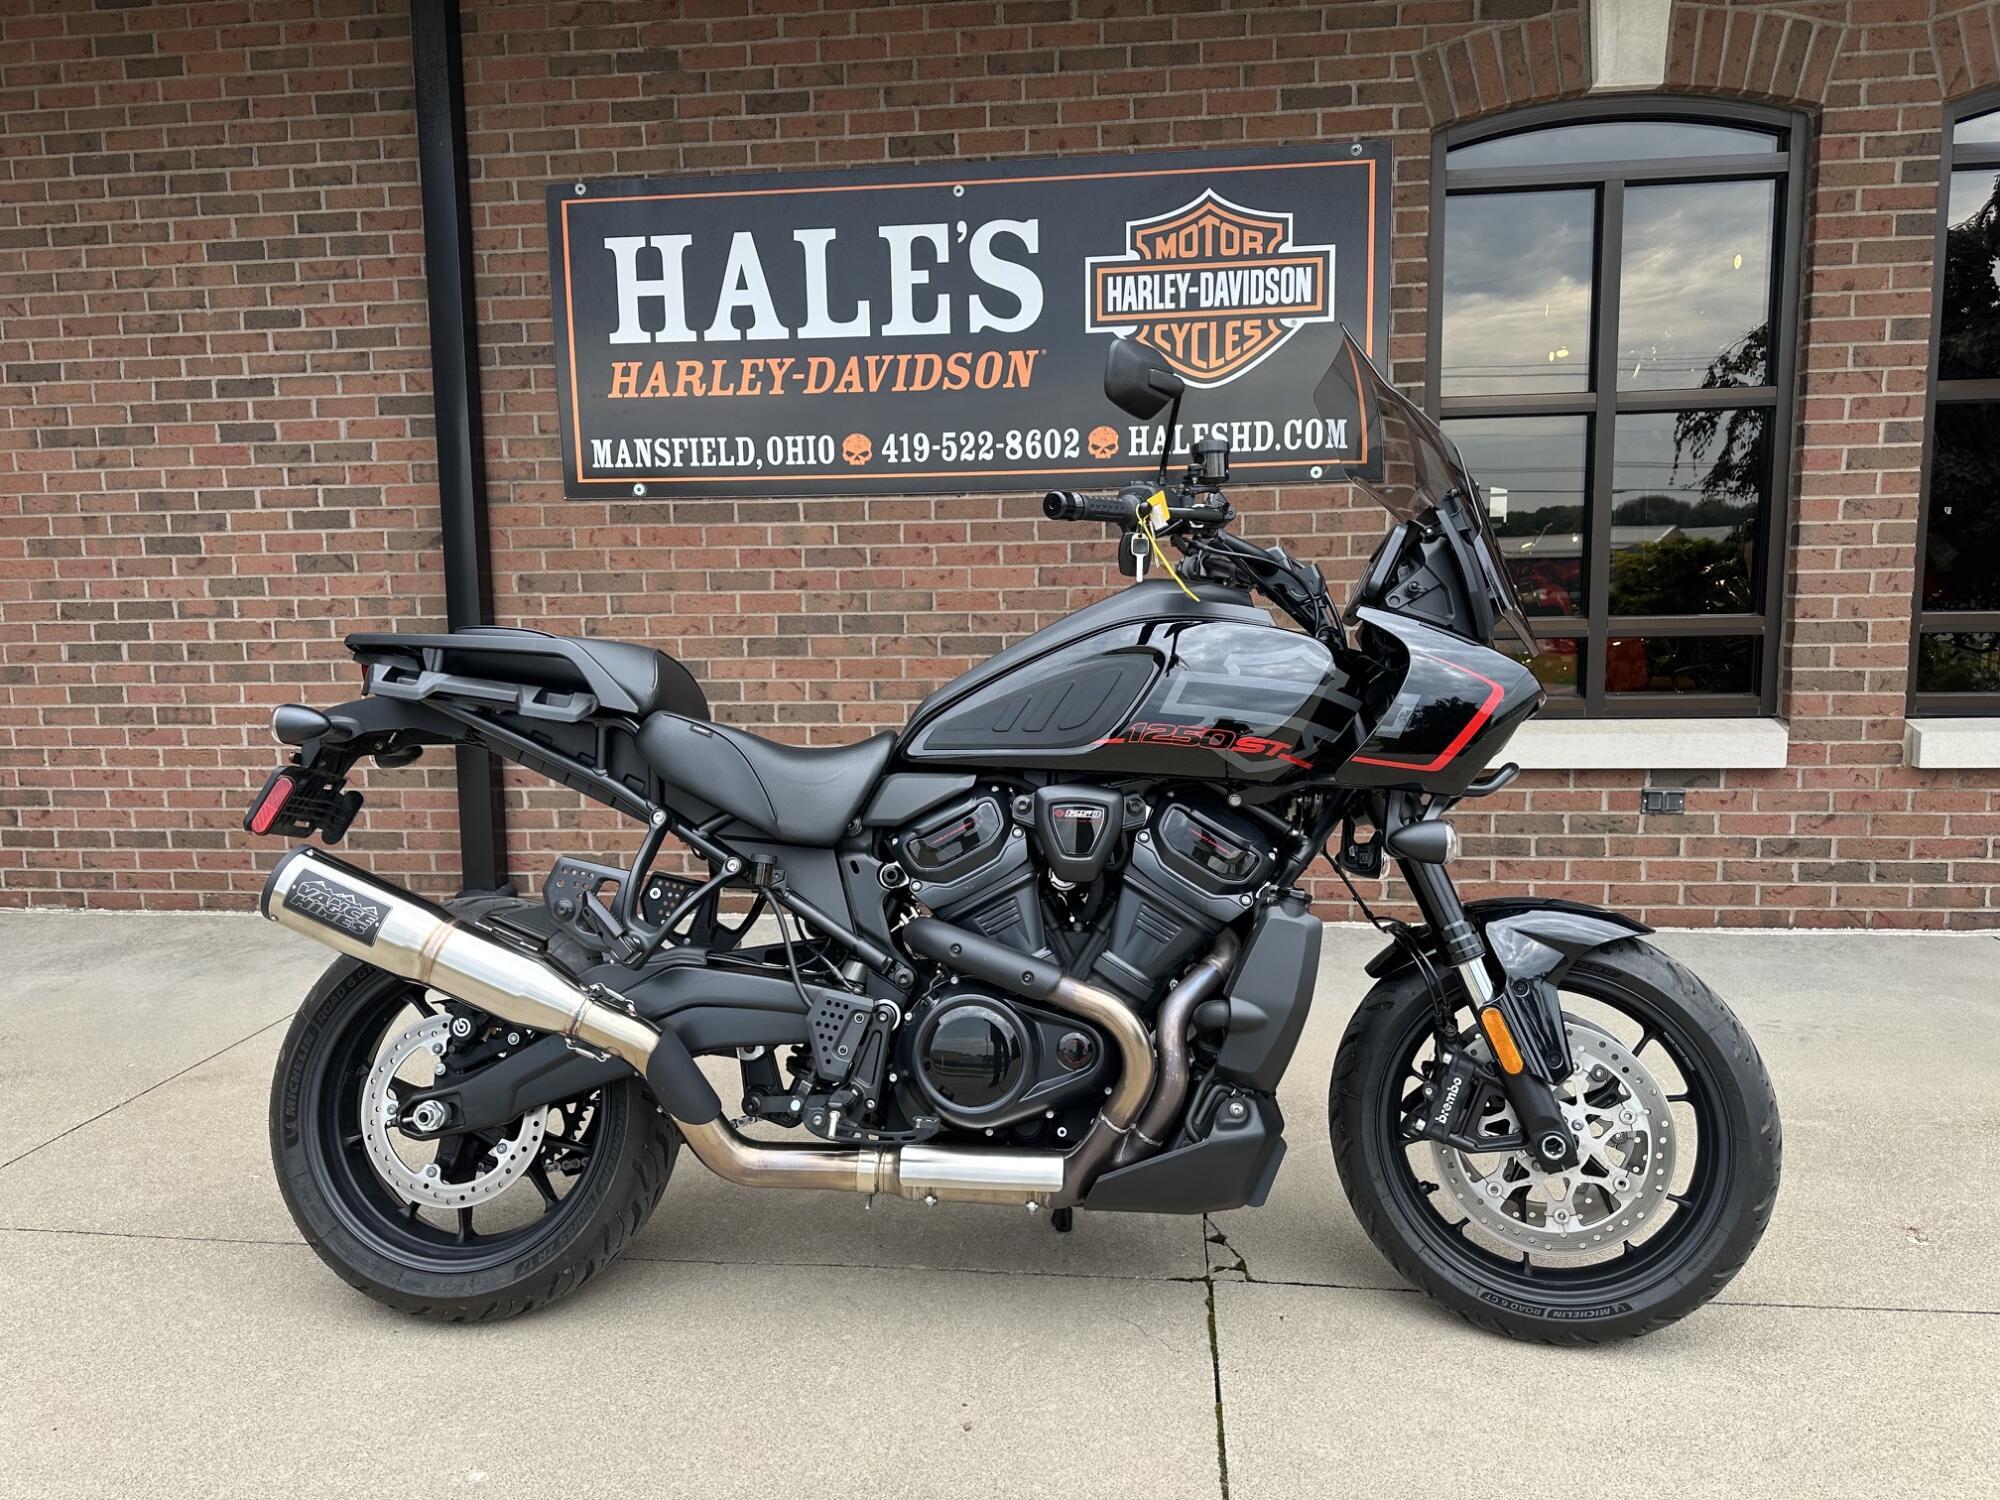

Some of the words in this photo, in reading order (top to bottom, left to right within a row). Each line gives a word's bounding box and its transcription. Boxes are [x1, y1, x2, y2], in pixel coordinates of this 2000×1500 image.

[1155, 214, 1264, 260] MOTOR
[604, 219, 1044, 344] HALE'S
[1107, 266, 1312, 312] HARLEY-DAVIDSON
[1154, 319, 1262, 370] CYCLES
[608, 348, 1040, 399] HARLEY-DAVIDSON
[881, 428, 1080, 463] 419-522-8602
[297, 883, 379, 928] VANCE
[285, 1032, 316, 1118] MICHELIN
[1435, 1077, 1462, 1124] brembo
[1510, 1302, 1542, 1316] ROAD
[1553, 1307, 1611, 1318] MICHELIN
